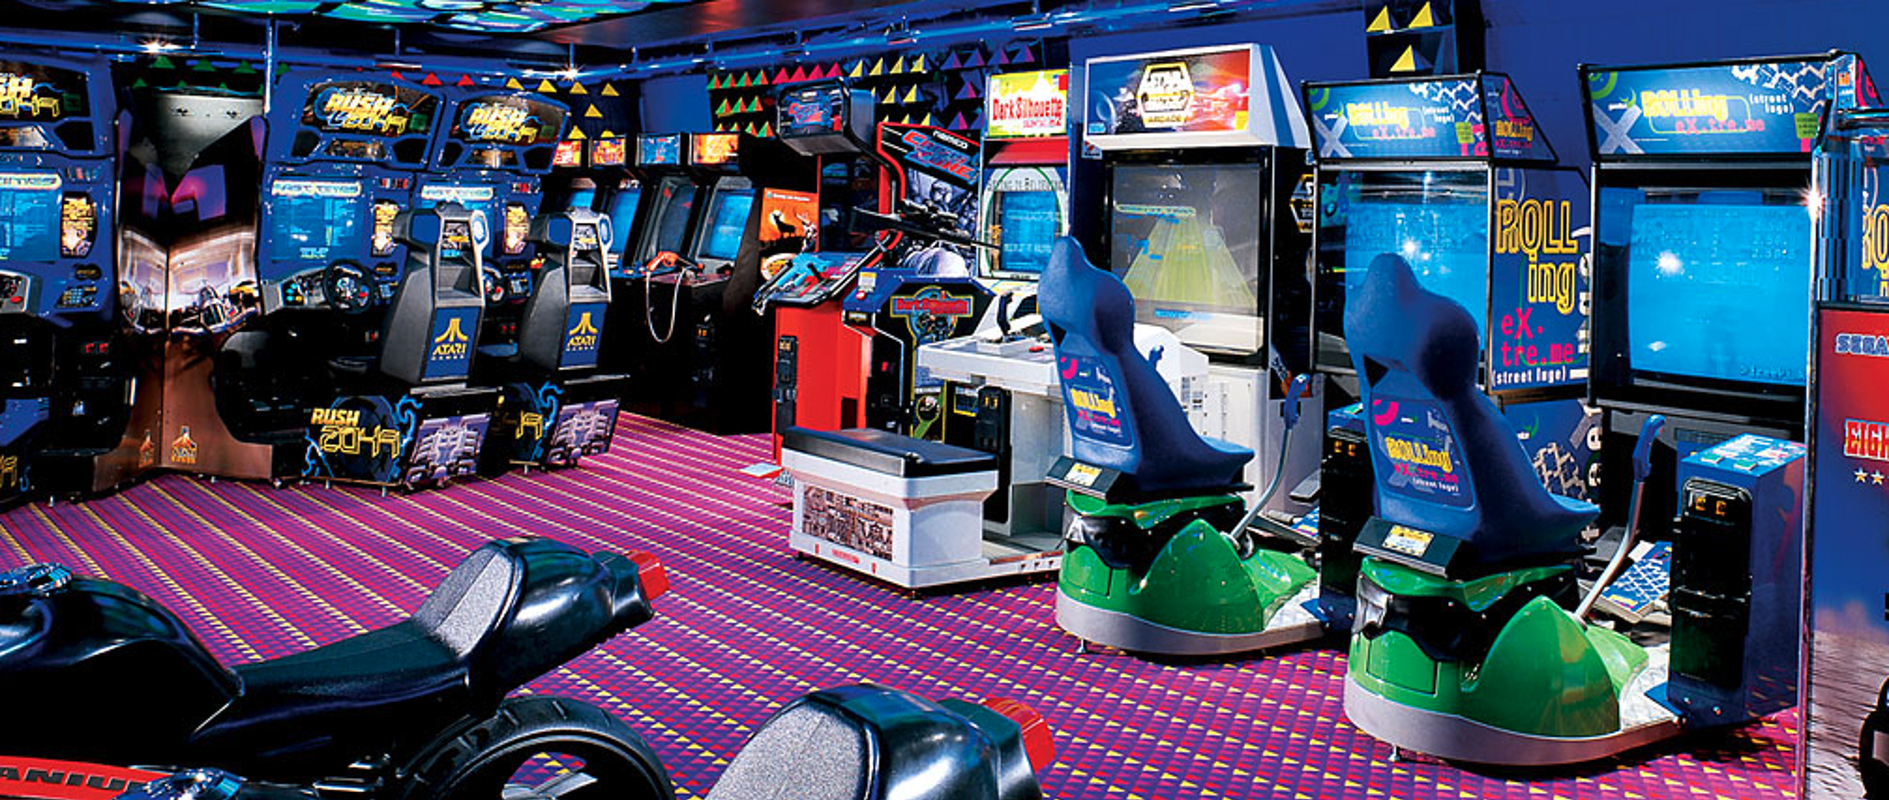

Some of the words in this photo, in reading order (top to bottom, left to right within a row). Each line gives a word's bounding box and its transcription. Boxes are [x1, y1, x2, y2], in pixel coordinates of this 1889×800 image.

[324, 93, 396, 115] RUSH
[993, 98, 1014, 120] Dark
[1016, 97, 1062, 119] Silhouette
[1496, 199, 1578, 254] ROLL
[1527, 252, 1575, 315] ing
[1501, 307, 1543, 340] eX.
[432, 343, 467, 355] ATARI
[1501, 341, 1574, 367] tre.me
[1835, 333, 1889, 357] SEGA
[1491, 369, 1532, 387] (street
[1536, 365, 1566, 384] luge)
[311, 407, 361, 427] RUSH
